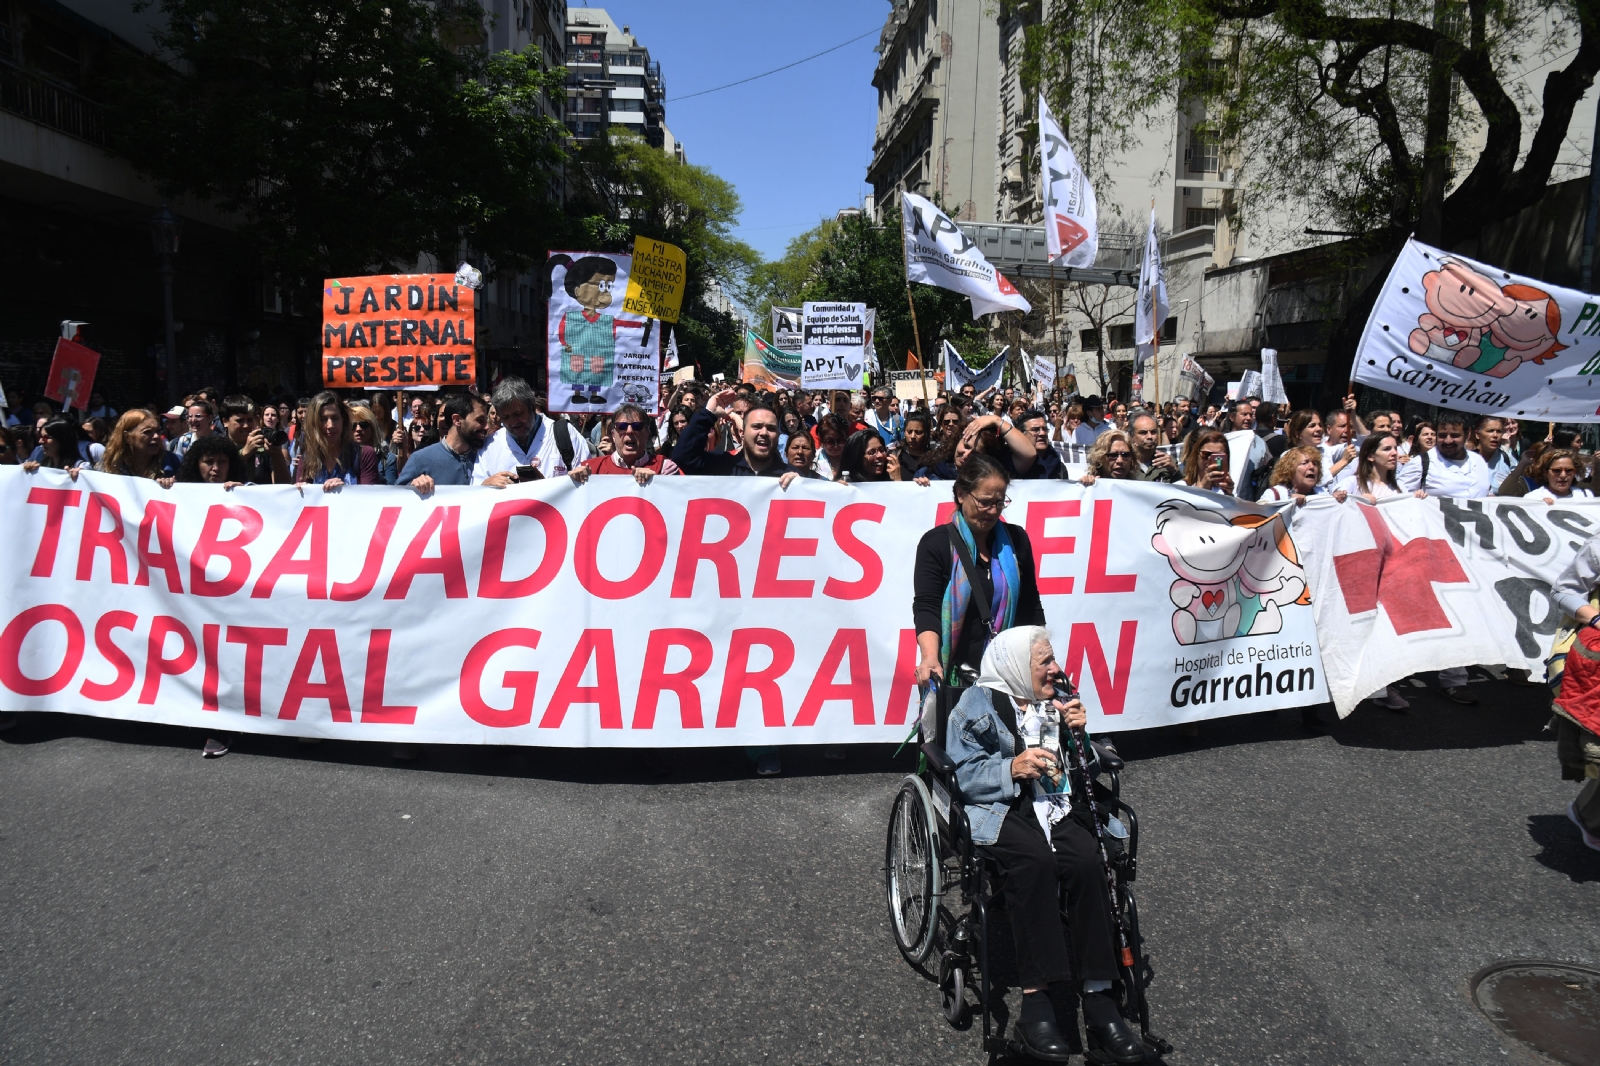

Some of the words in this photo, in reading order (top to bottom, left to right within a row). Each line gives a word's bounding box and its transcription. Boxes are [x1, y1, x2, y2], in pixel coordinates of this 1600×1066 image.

[652, 242, 665, 255] MI
[635, 251, 683, 274] MAESTRA
[943, 253, 993, 276] Garrahan
[633, 263, 682, 285] LUCHANDO
[637, 275, 674, 295] TAMBIÉN
[334, 278, 459, 315] JARDÍN
[625, 297, 678, 320] ENSEÑANDO
[807, 315, 830, 324] Equipo
[831, 315, 839, 323] de
[840, 315, 862, 324] Salud,
[812, 304, 851, 313] Comunidad
[324, 319, 472, 349] MATERNAL
[807, 336, 821, 344] del
[822, 335, 862, 344] Garrahan
[811, 326, 822, 334] en
[823, 325, 857, 334] defensa
[617, 363, 656, 371] MATERNAL
[623, 352, 651, 360] JARDIN
[803, 355, 845, 373] APyT
[325, 354, 472, 383] PRESENTE
[1386, 355, 1512, 409] Garrahan
[27, 487, 886, 602] TRABAJADORES
[1174, 649, 1223, 675] Hospital
[1226, 648, 1244, 665] de
[1248, 641, 1312, 663] Pediatría
[1170, 662, 1315, 708] Garrahan
